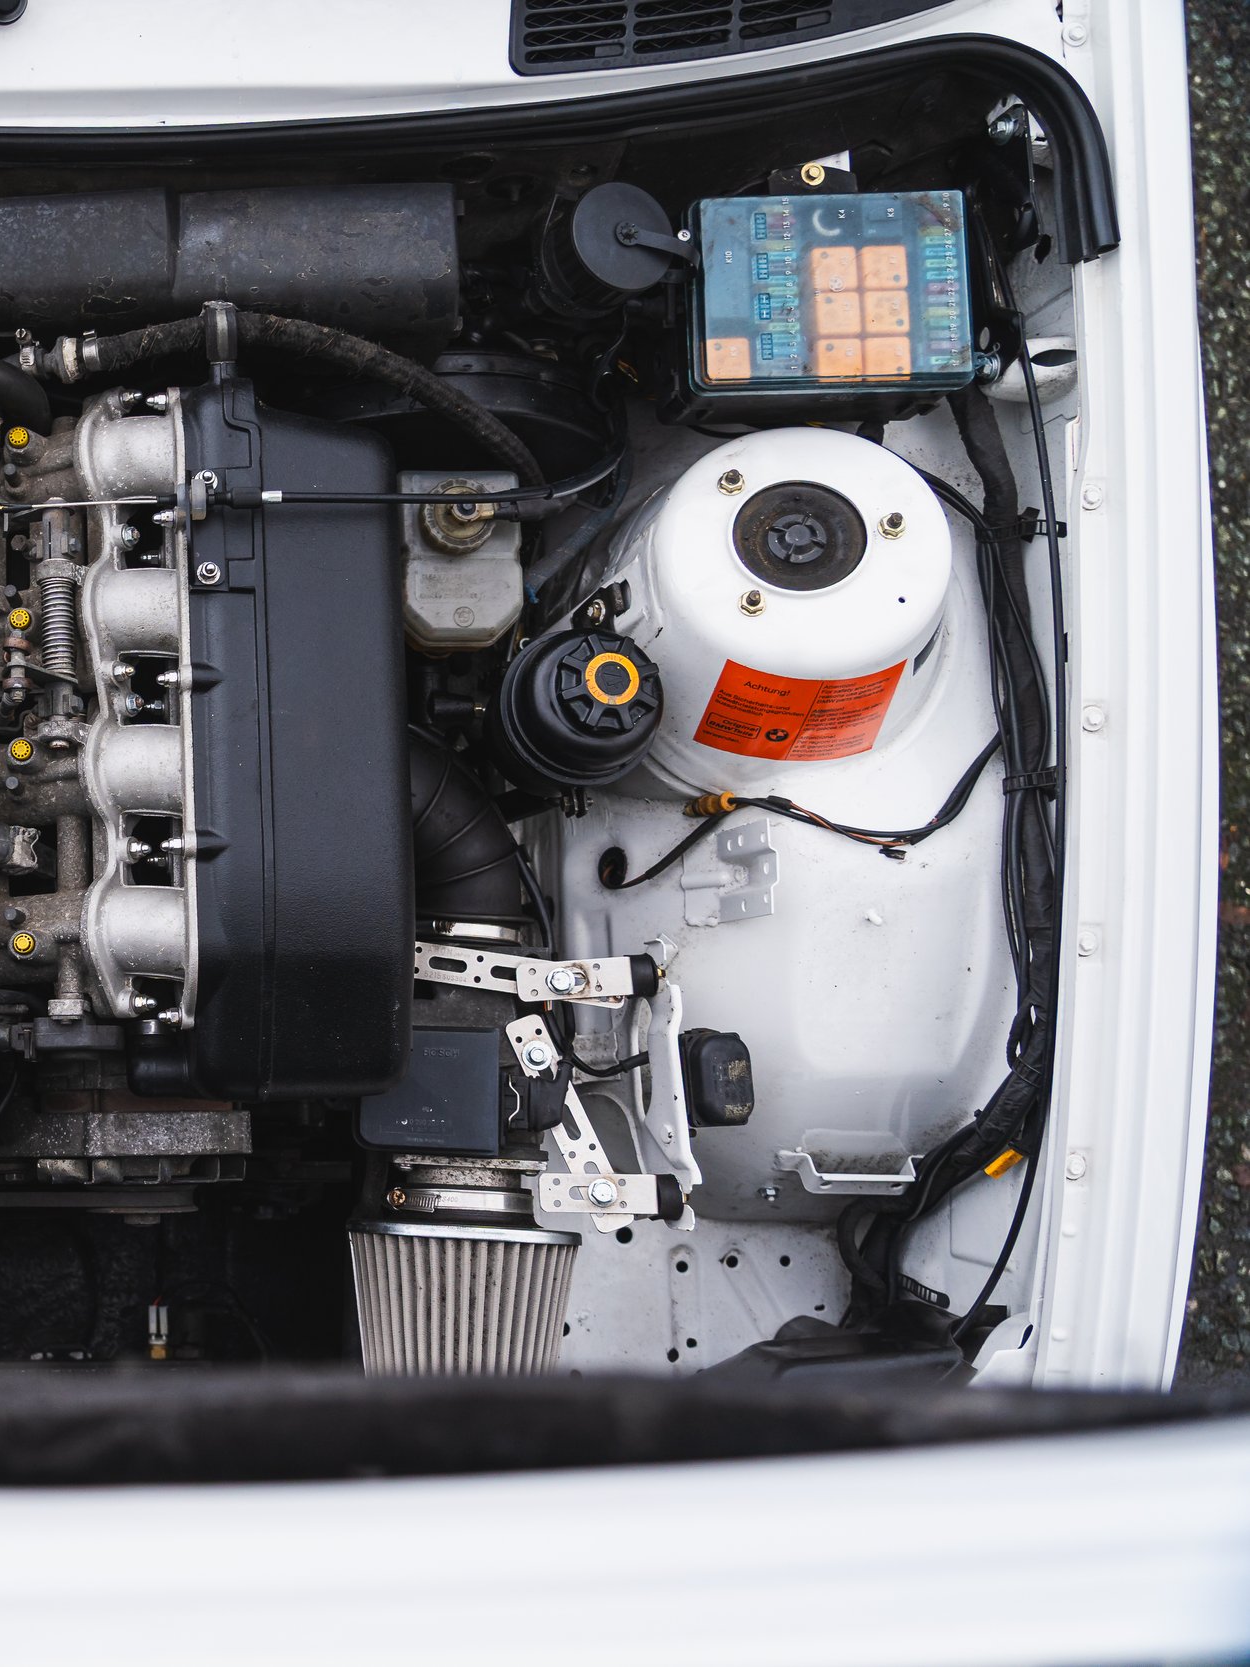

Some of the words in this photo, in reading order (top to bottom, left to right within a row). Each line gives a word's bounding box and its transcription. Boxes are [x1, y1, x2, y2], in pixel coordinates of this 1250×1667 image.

[782, 197, 790, 206] 15
[782, 209, 790, 217] 14
[838, 208, 846, 220] K4
[886, 208, 894, 218] K8
[783, 221, 790, 229] 13
[944, 228, 952, 237] 27
[946, 240, 952, 248] 26
[785, 256, 792, 265] 10
[946, 252, 953, 261] 25
[947, 274, 954, 284] 23
[948, 288, 955, 296] 22
[950, 311, 956, 320] 20
[950, 323, 958, 332] 19
[588, 665, 596, 676] OIL
[600, 654, 623, 662] ONLY
[743, 680, 791, 698] Achtung!
[722, 718, 759, 732] Original
[422, 1048, 460, 1058] BOSCH
